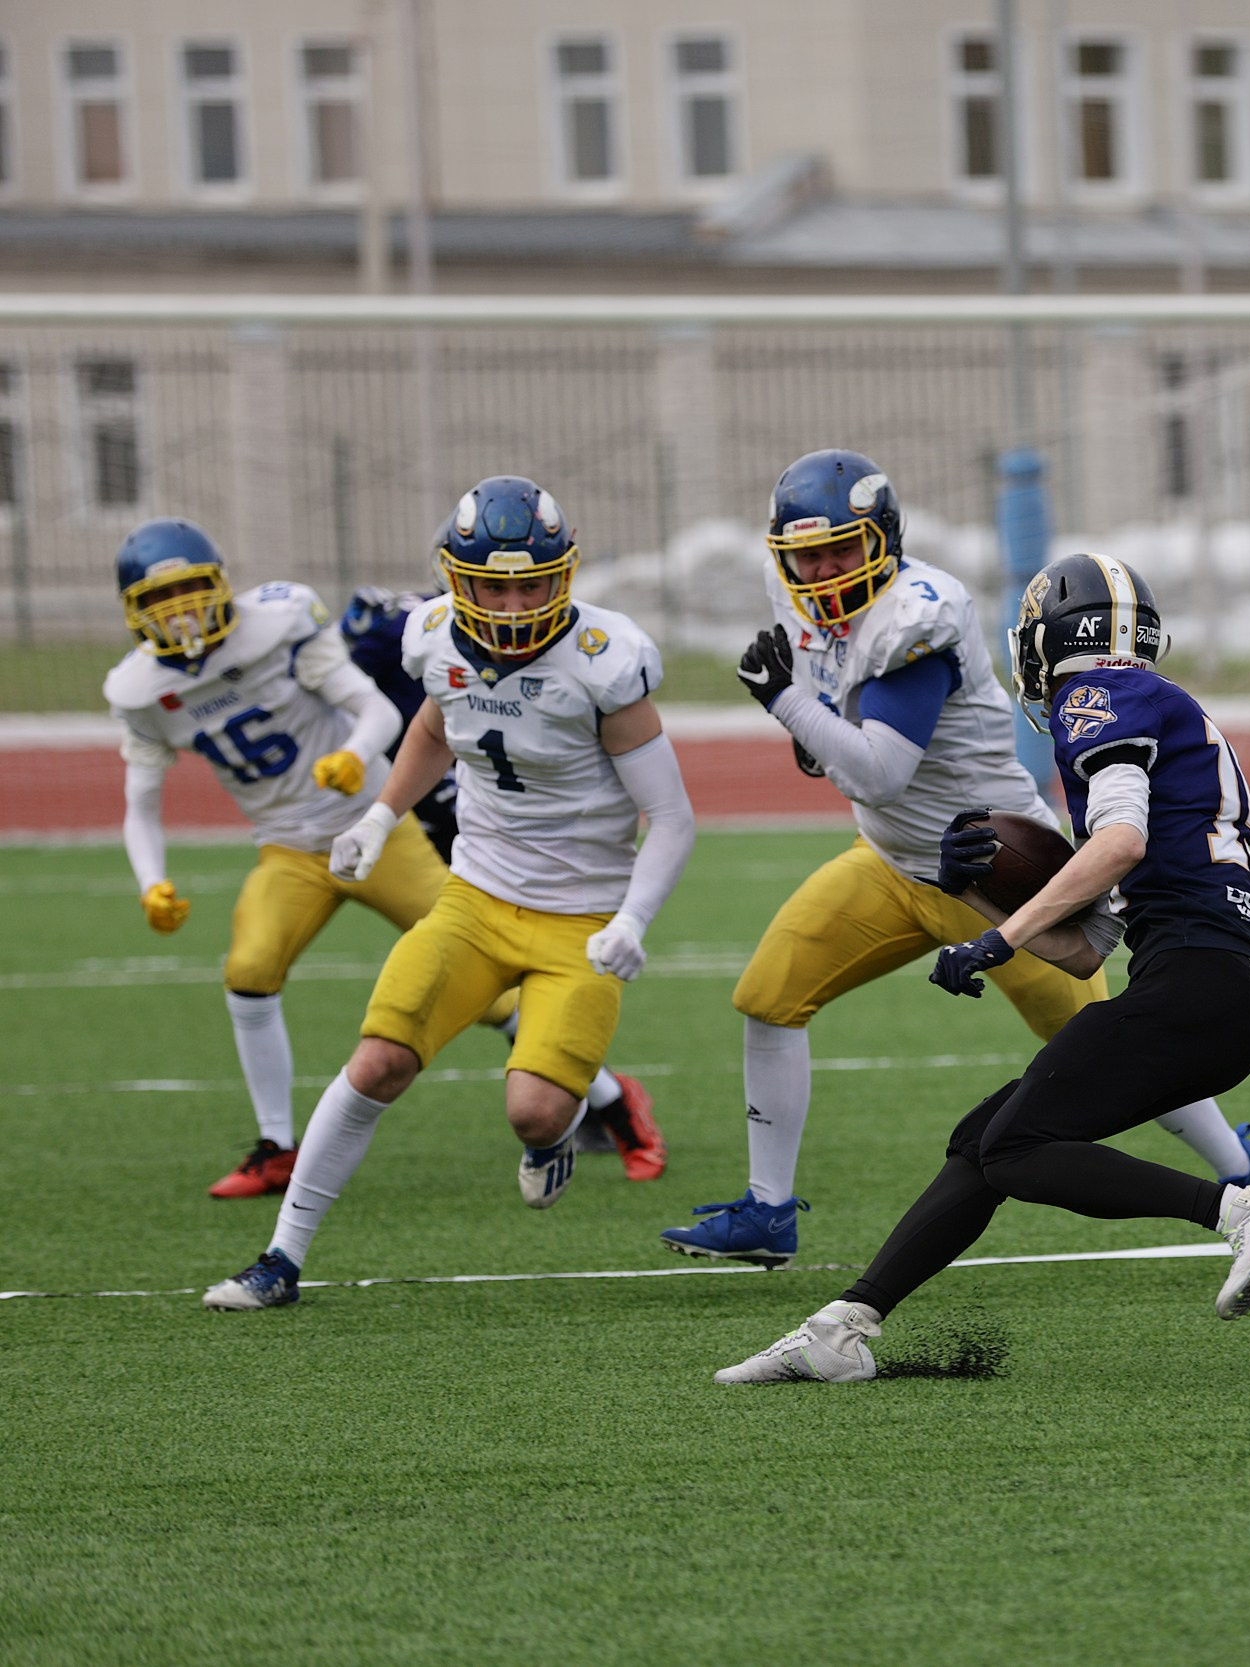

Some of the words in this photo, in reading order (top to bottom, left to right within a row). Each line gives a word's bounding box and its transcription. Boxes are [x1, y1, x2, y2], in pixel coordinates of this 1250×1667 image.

[910, 580, 939, 601] 3
[466, 694, 522, 717] VIKINGS
[193, 707, 298, 784] 16
[477, 729, 525, 792] 1
